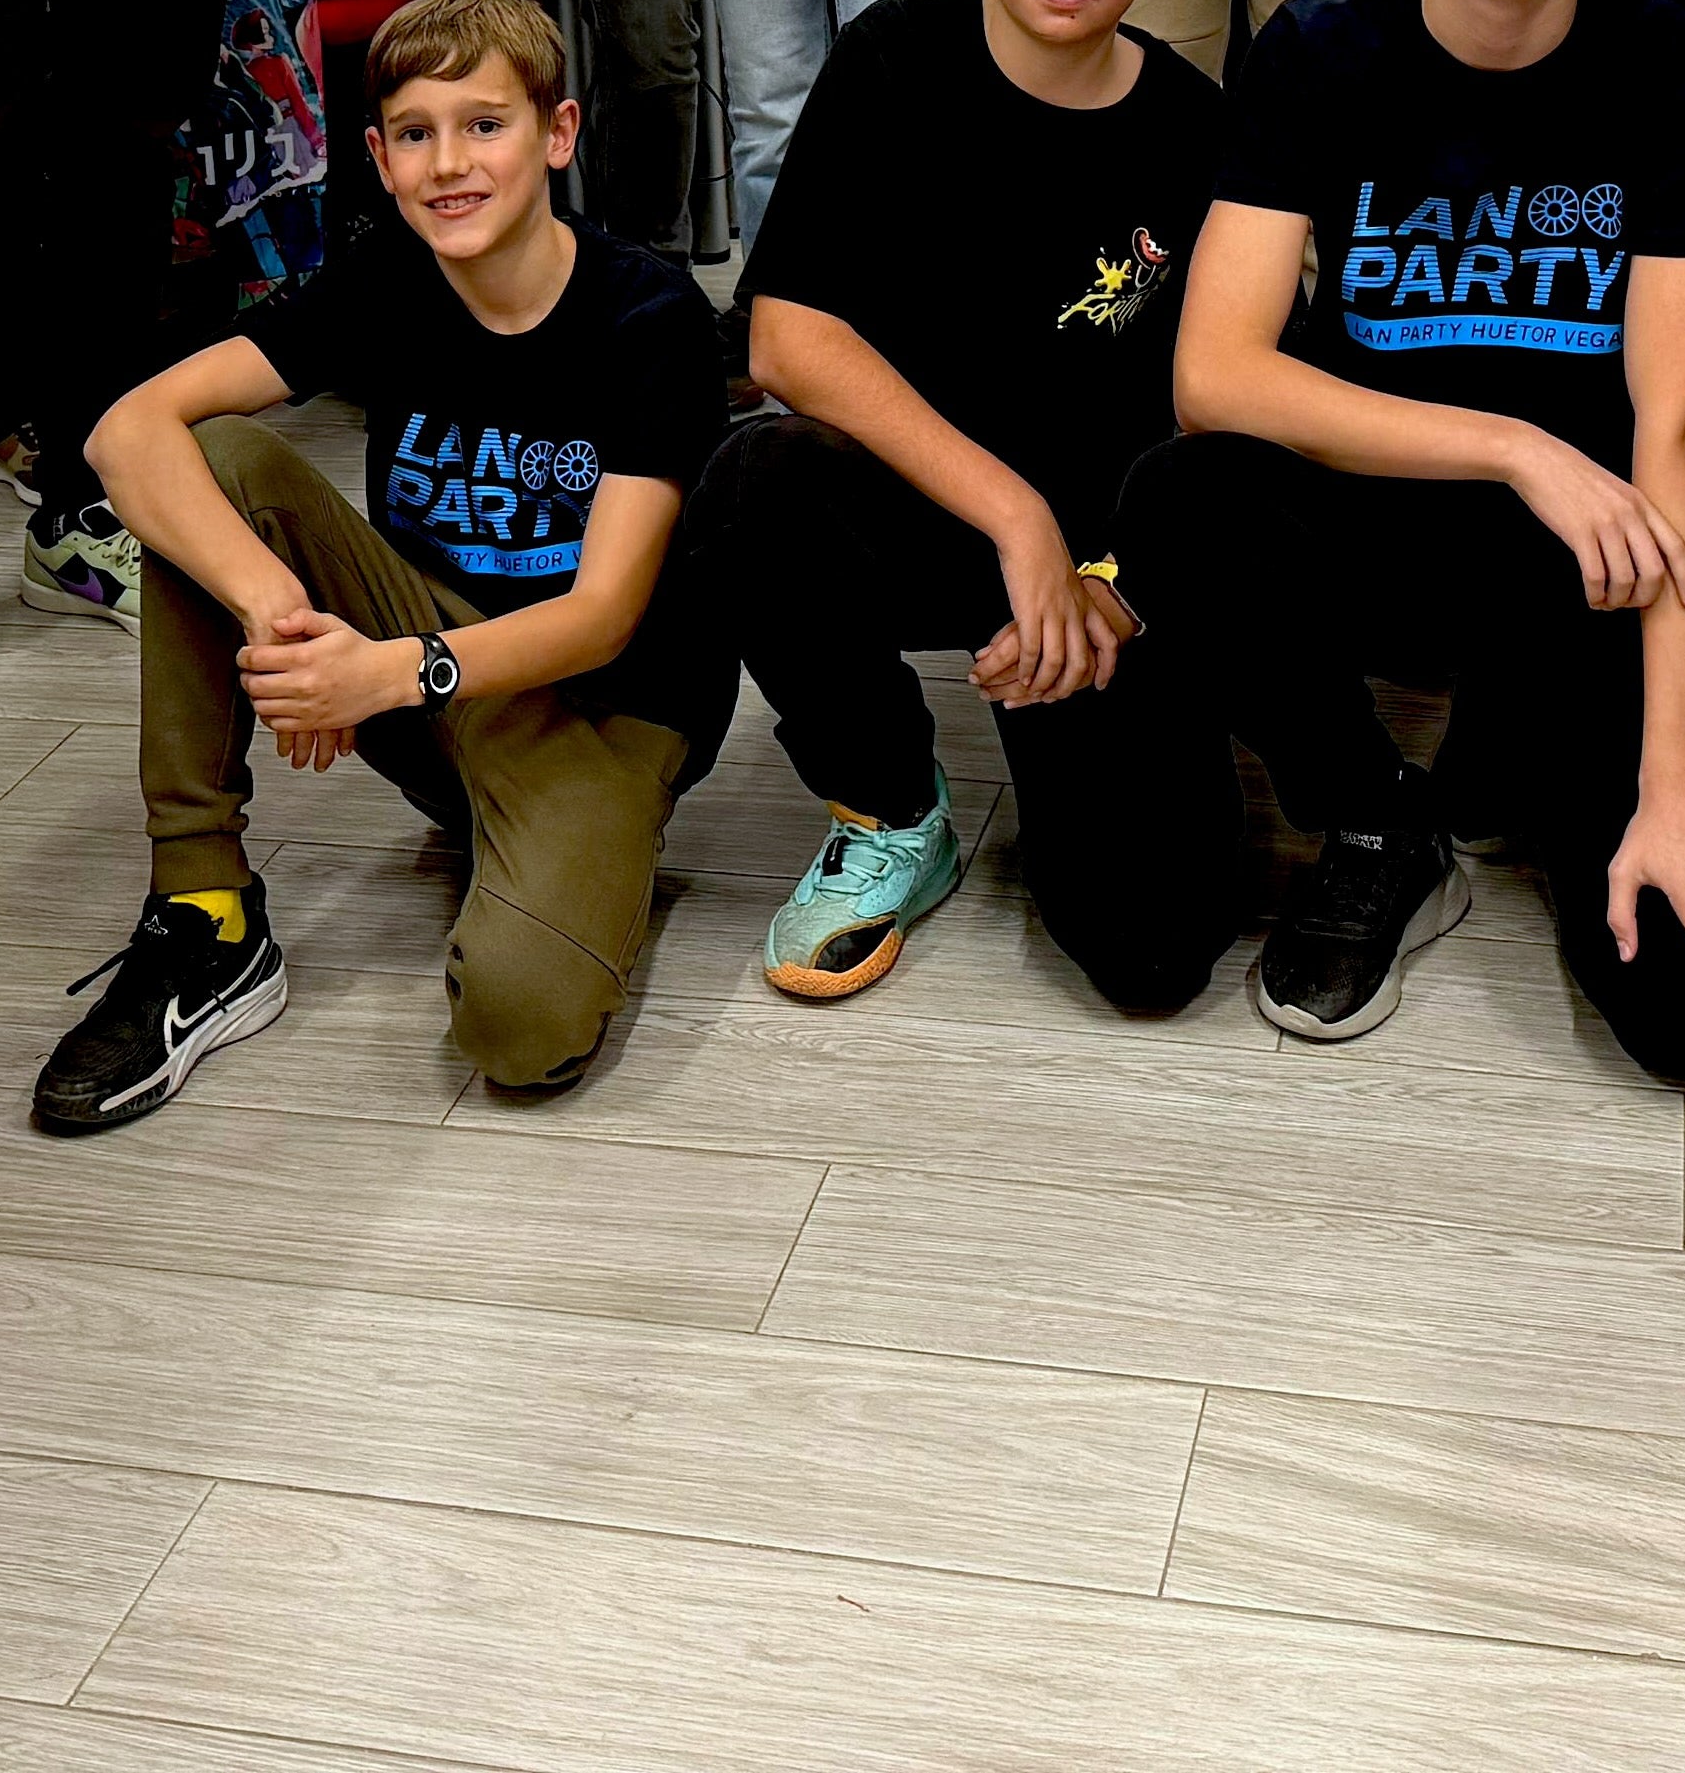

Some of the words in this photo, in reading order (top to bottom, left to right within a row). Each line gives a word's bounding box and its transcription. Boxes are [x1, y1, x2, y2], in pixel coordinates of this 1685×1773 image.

[1352, 182, 1523, 241] LAN
[1342, 244, 1625, 311] PARTY
[1355, 322, 1391, 344] LAN
[1400, 323, 1462, 344] PARTY
[1565, 330, 1623, 348] VEGA
[396, 413, 522, 479] LAN
[451, 552, 488, 568] RTY
